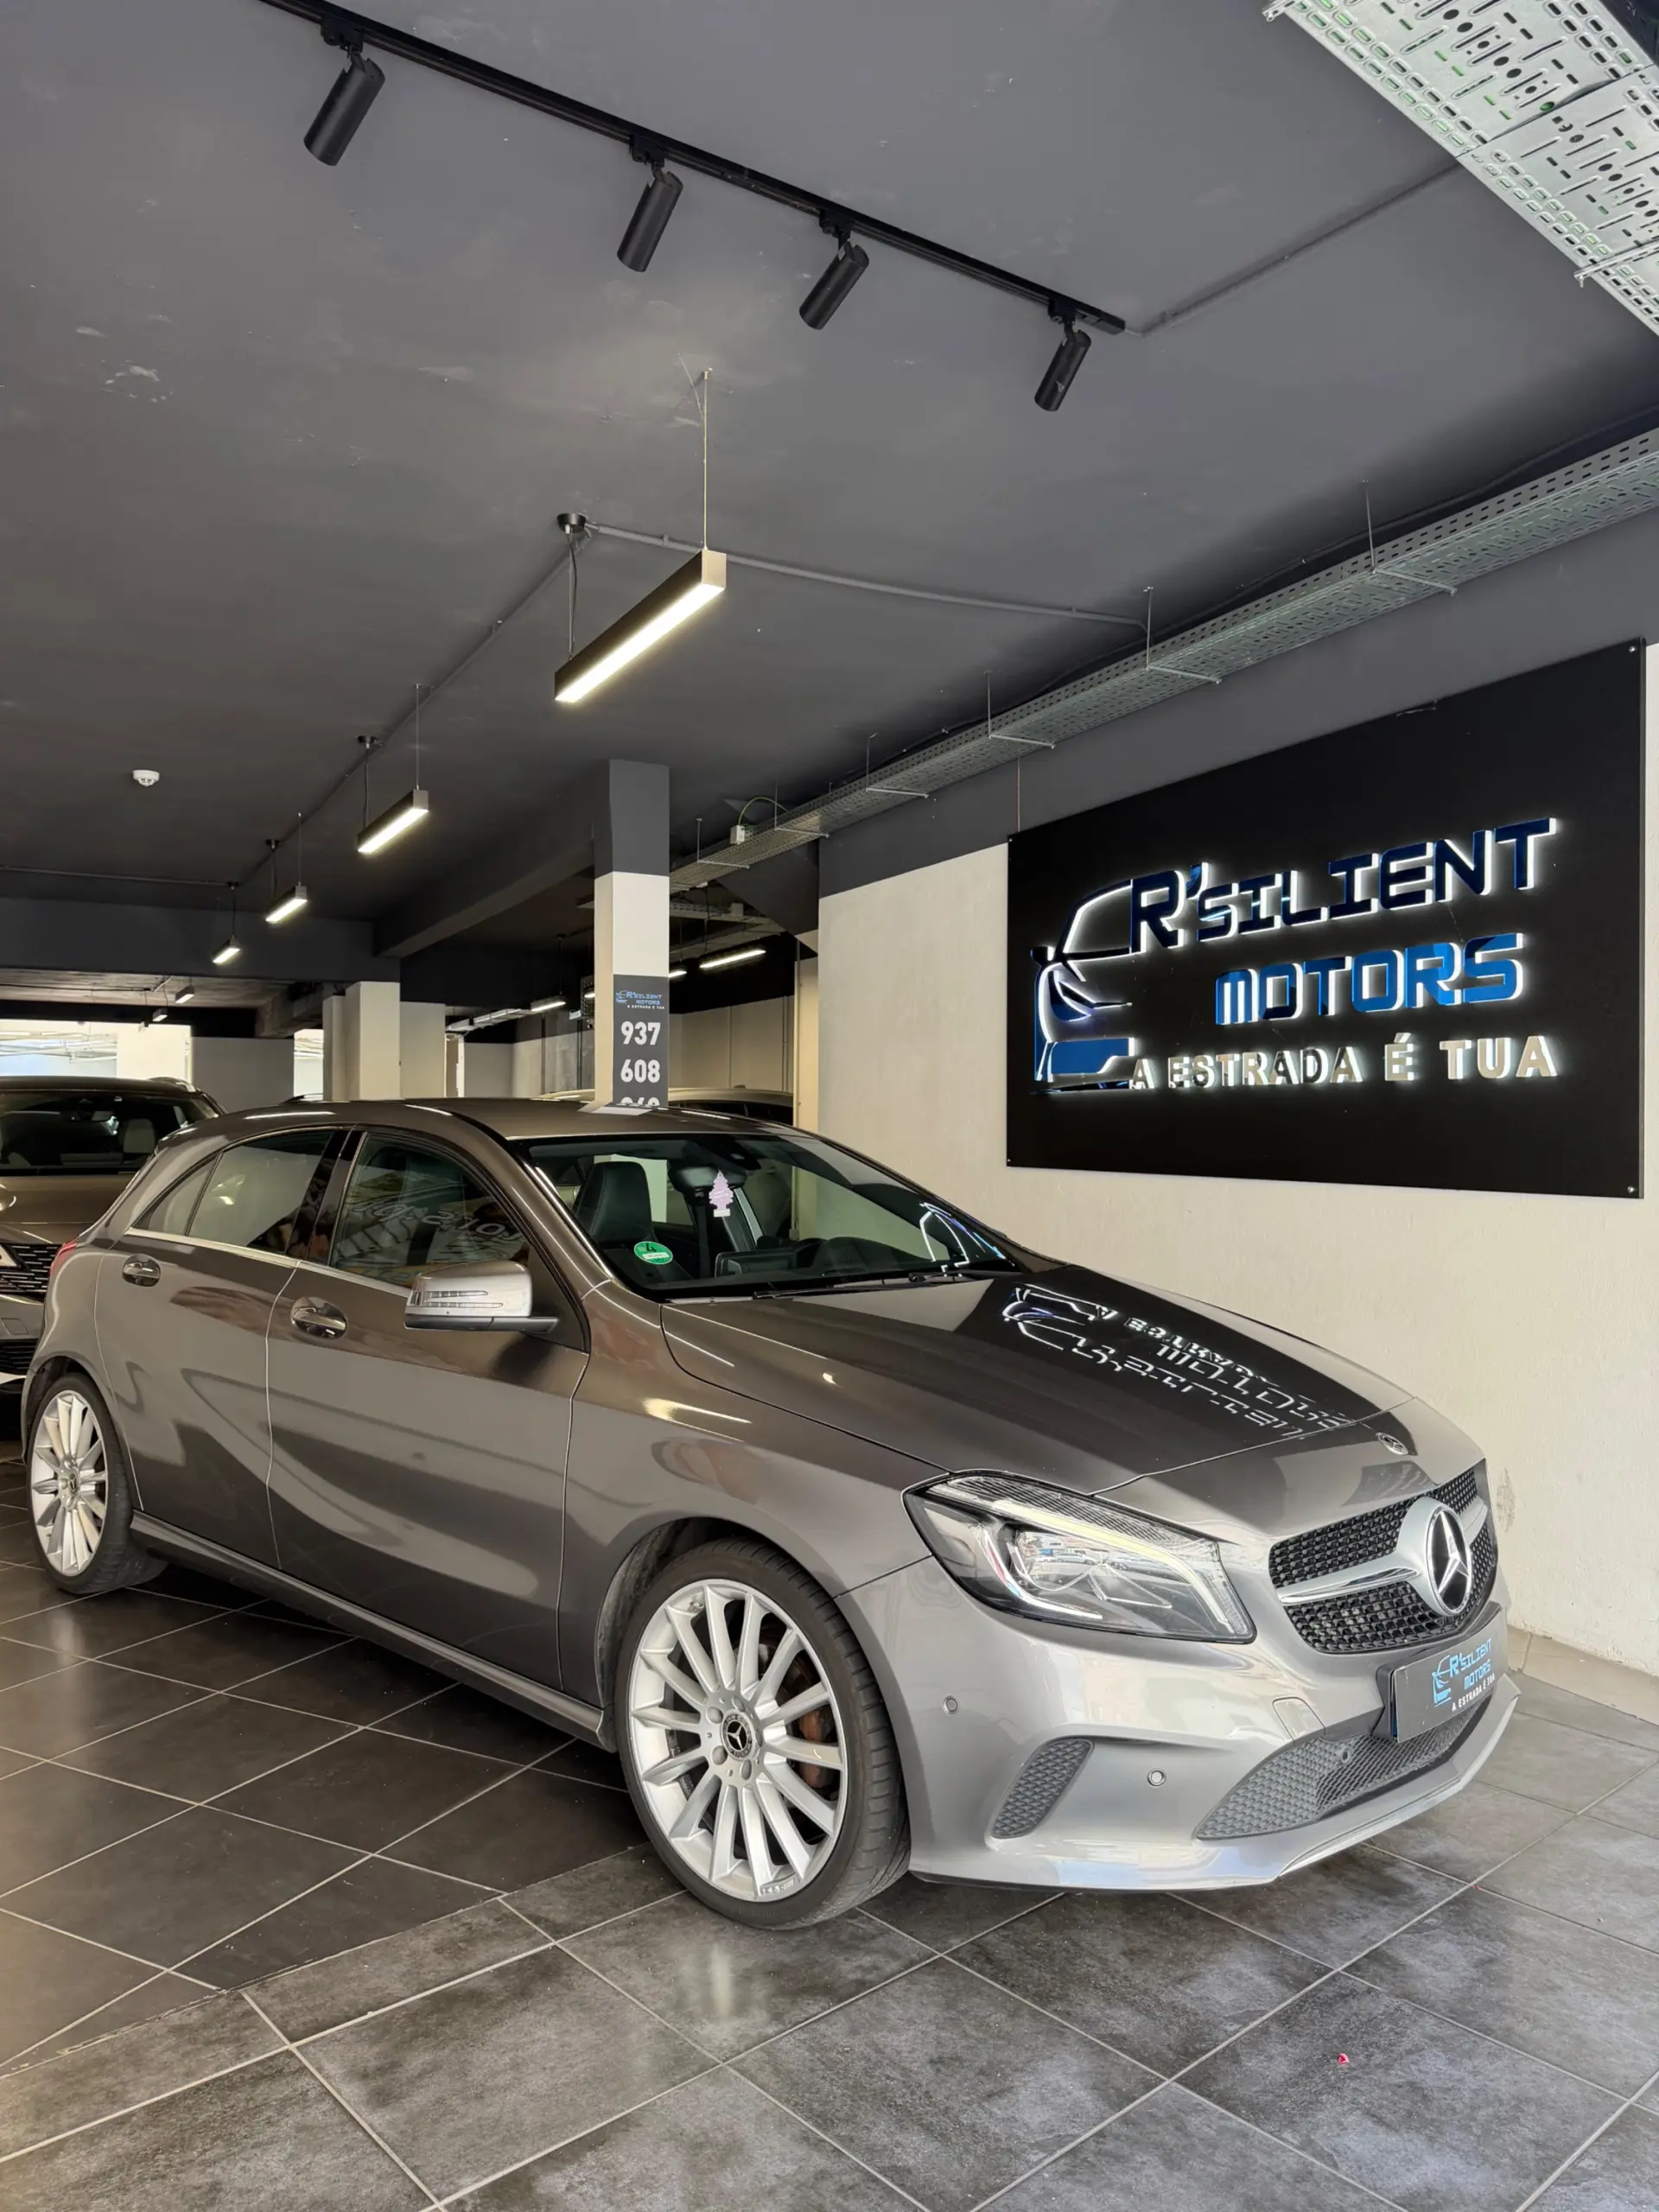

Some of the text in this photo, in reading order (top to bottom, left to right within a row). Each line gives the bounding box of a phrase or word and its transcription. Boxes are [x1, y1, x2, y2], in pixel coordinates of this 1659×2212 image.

[1129, 817, 1556, 954] R'SILIENT
[1216, 933, 1523, 1025] MOTORS
[621, 1020, 661, 1046] 937
[620, 1059, 660, 1083] 608
[1129, 1033, 1558, 1089] A ESTRADA É TUA
[1464, 1659, 1491, 1690] MOTORS
[1452, 1701, 1458, 1712] A
[1458, 1684, 1483, 1708] ESTRADA
